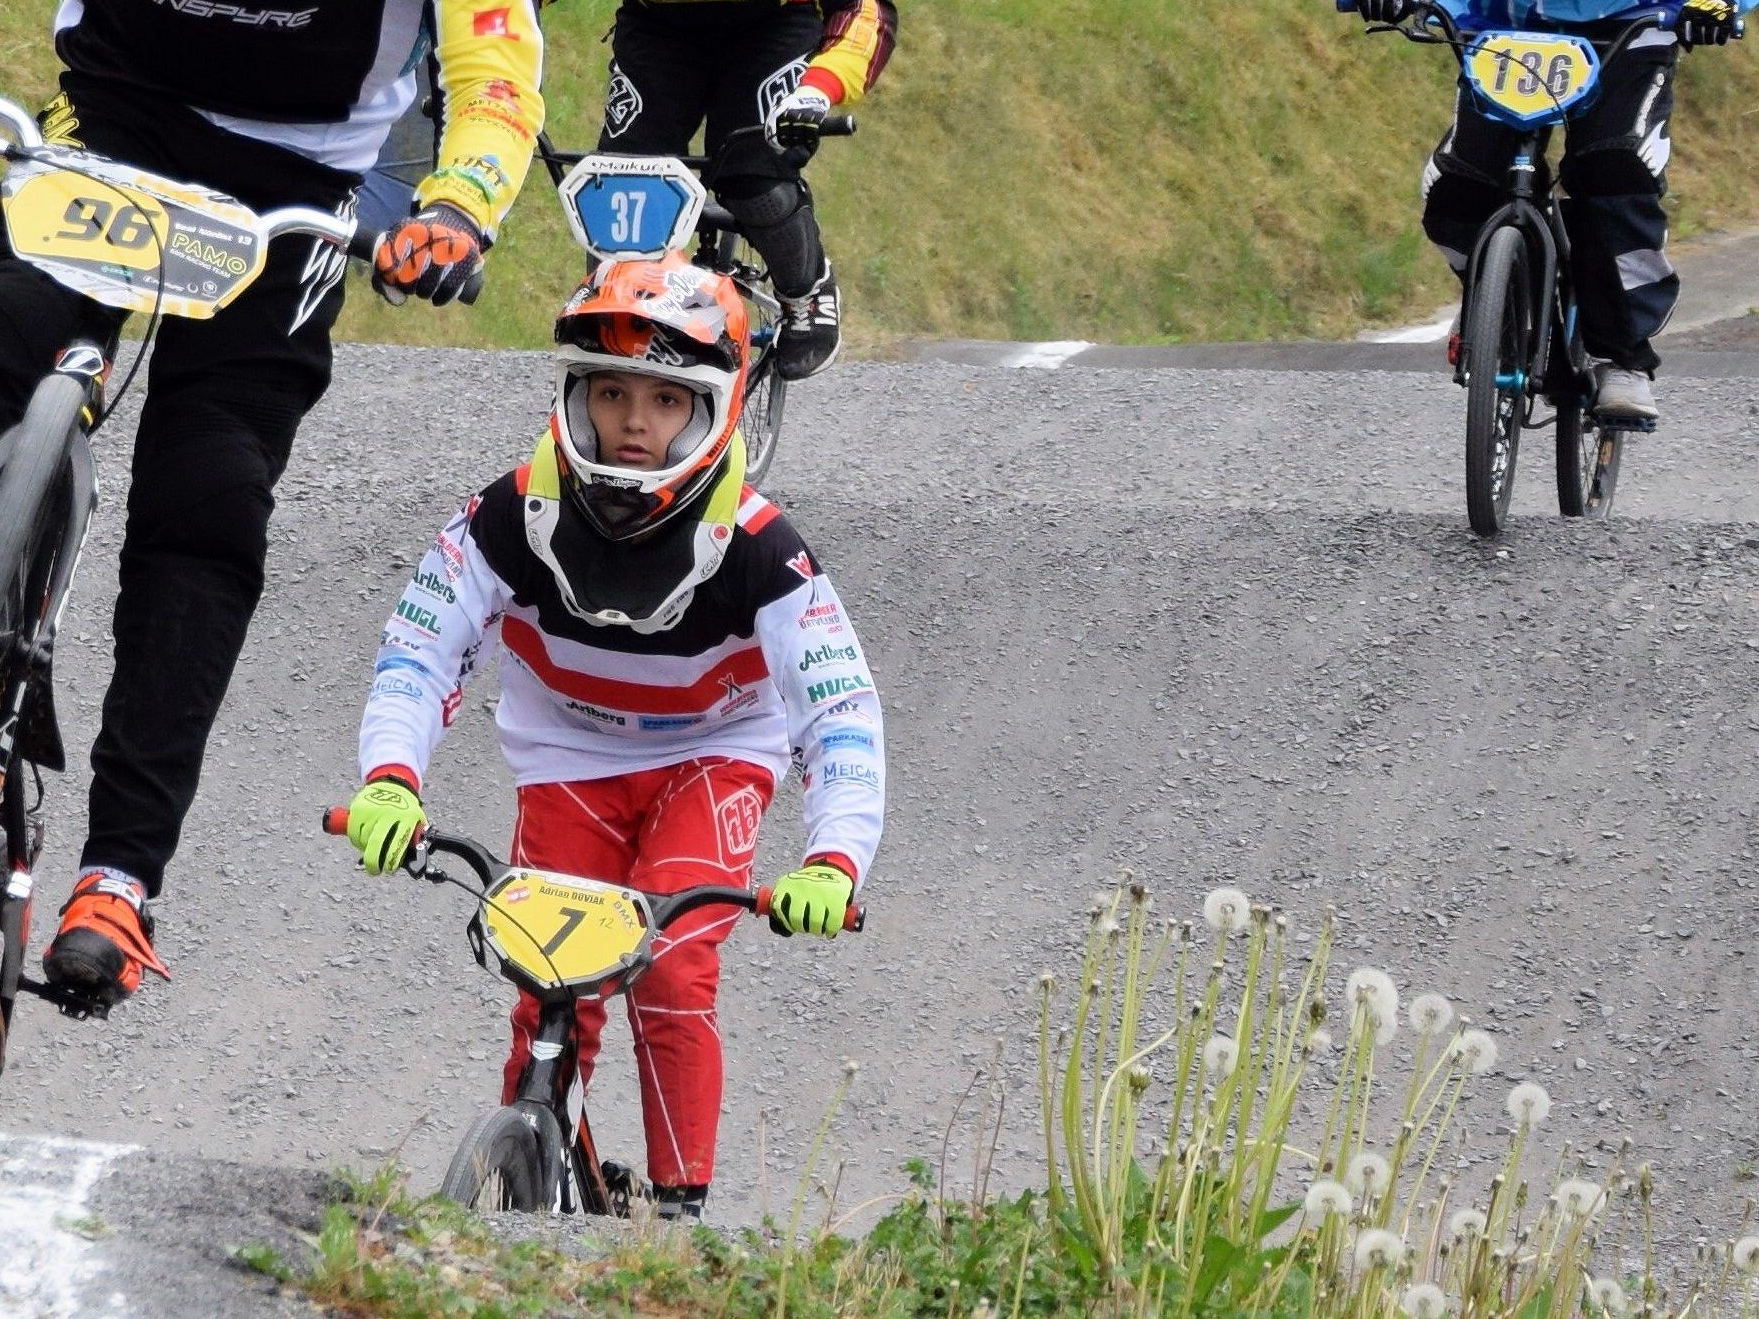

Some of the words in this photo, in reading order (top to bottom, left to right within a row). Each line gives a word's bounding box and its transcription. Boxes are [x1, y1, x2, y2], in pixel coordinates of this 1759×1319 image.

[1492, 47, 1573, 98] 136
[56, 196, 162, 251] 96
[610, 191, 647, 243] 37
[172, 232, 246, 275] PAMO
[807, 675, 872, 704] HUGL
[566, 701, 626, 726] Arlberg
[823, 761, 879, 786] MEICAS
[613, 900, 636, 929] BMX
